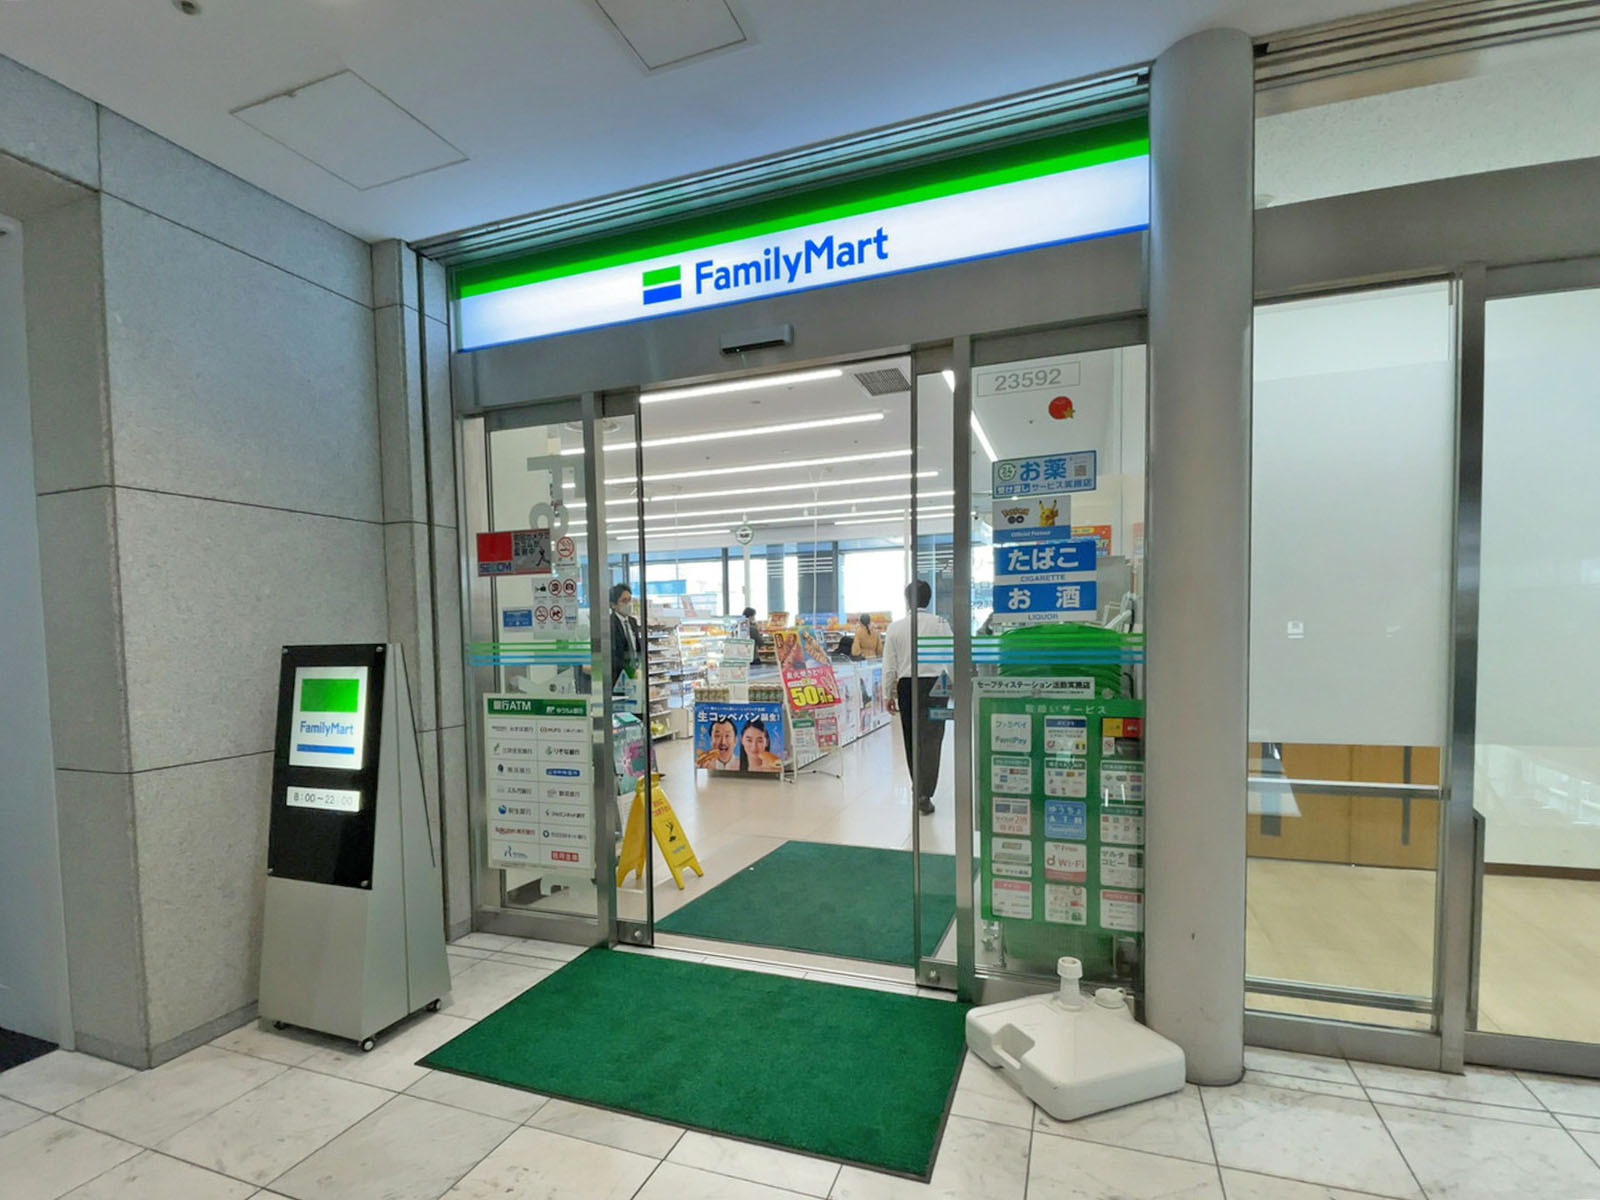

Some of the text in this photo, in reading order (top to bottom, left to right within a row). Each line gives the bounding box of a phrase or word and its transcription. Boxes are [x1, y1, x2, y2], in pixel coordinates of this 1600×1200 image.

[695, 227, 888, 295] FamilyMart
[994, 368, 1061, 391] 23592
[1019, 458, 1067, 481] お薬
[1008, 546, 1079, 571] たばこ
[1020, 574, 1066, 582] CIGARETTE
[300, 720, 354, 737] FamilyMart
